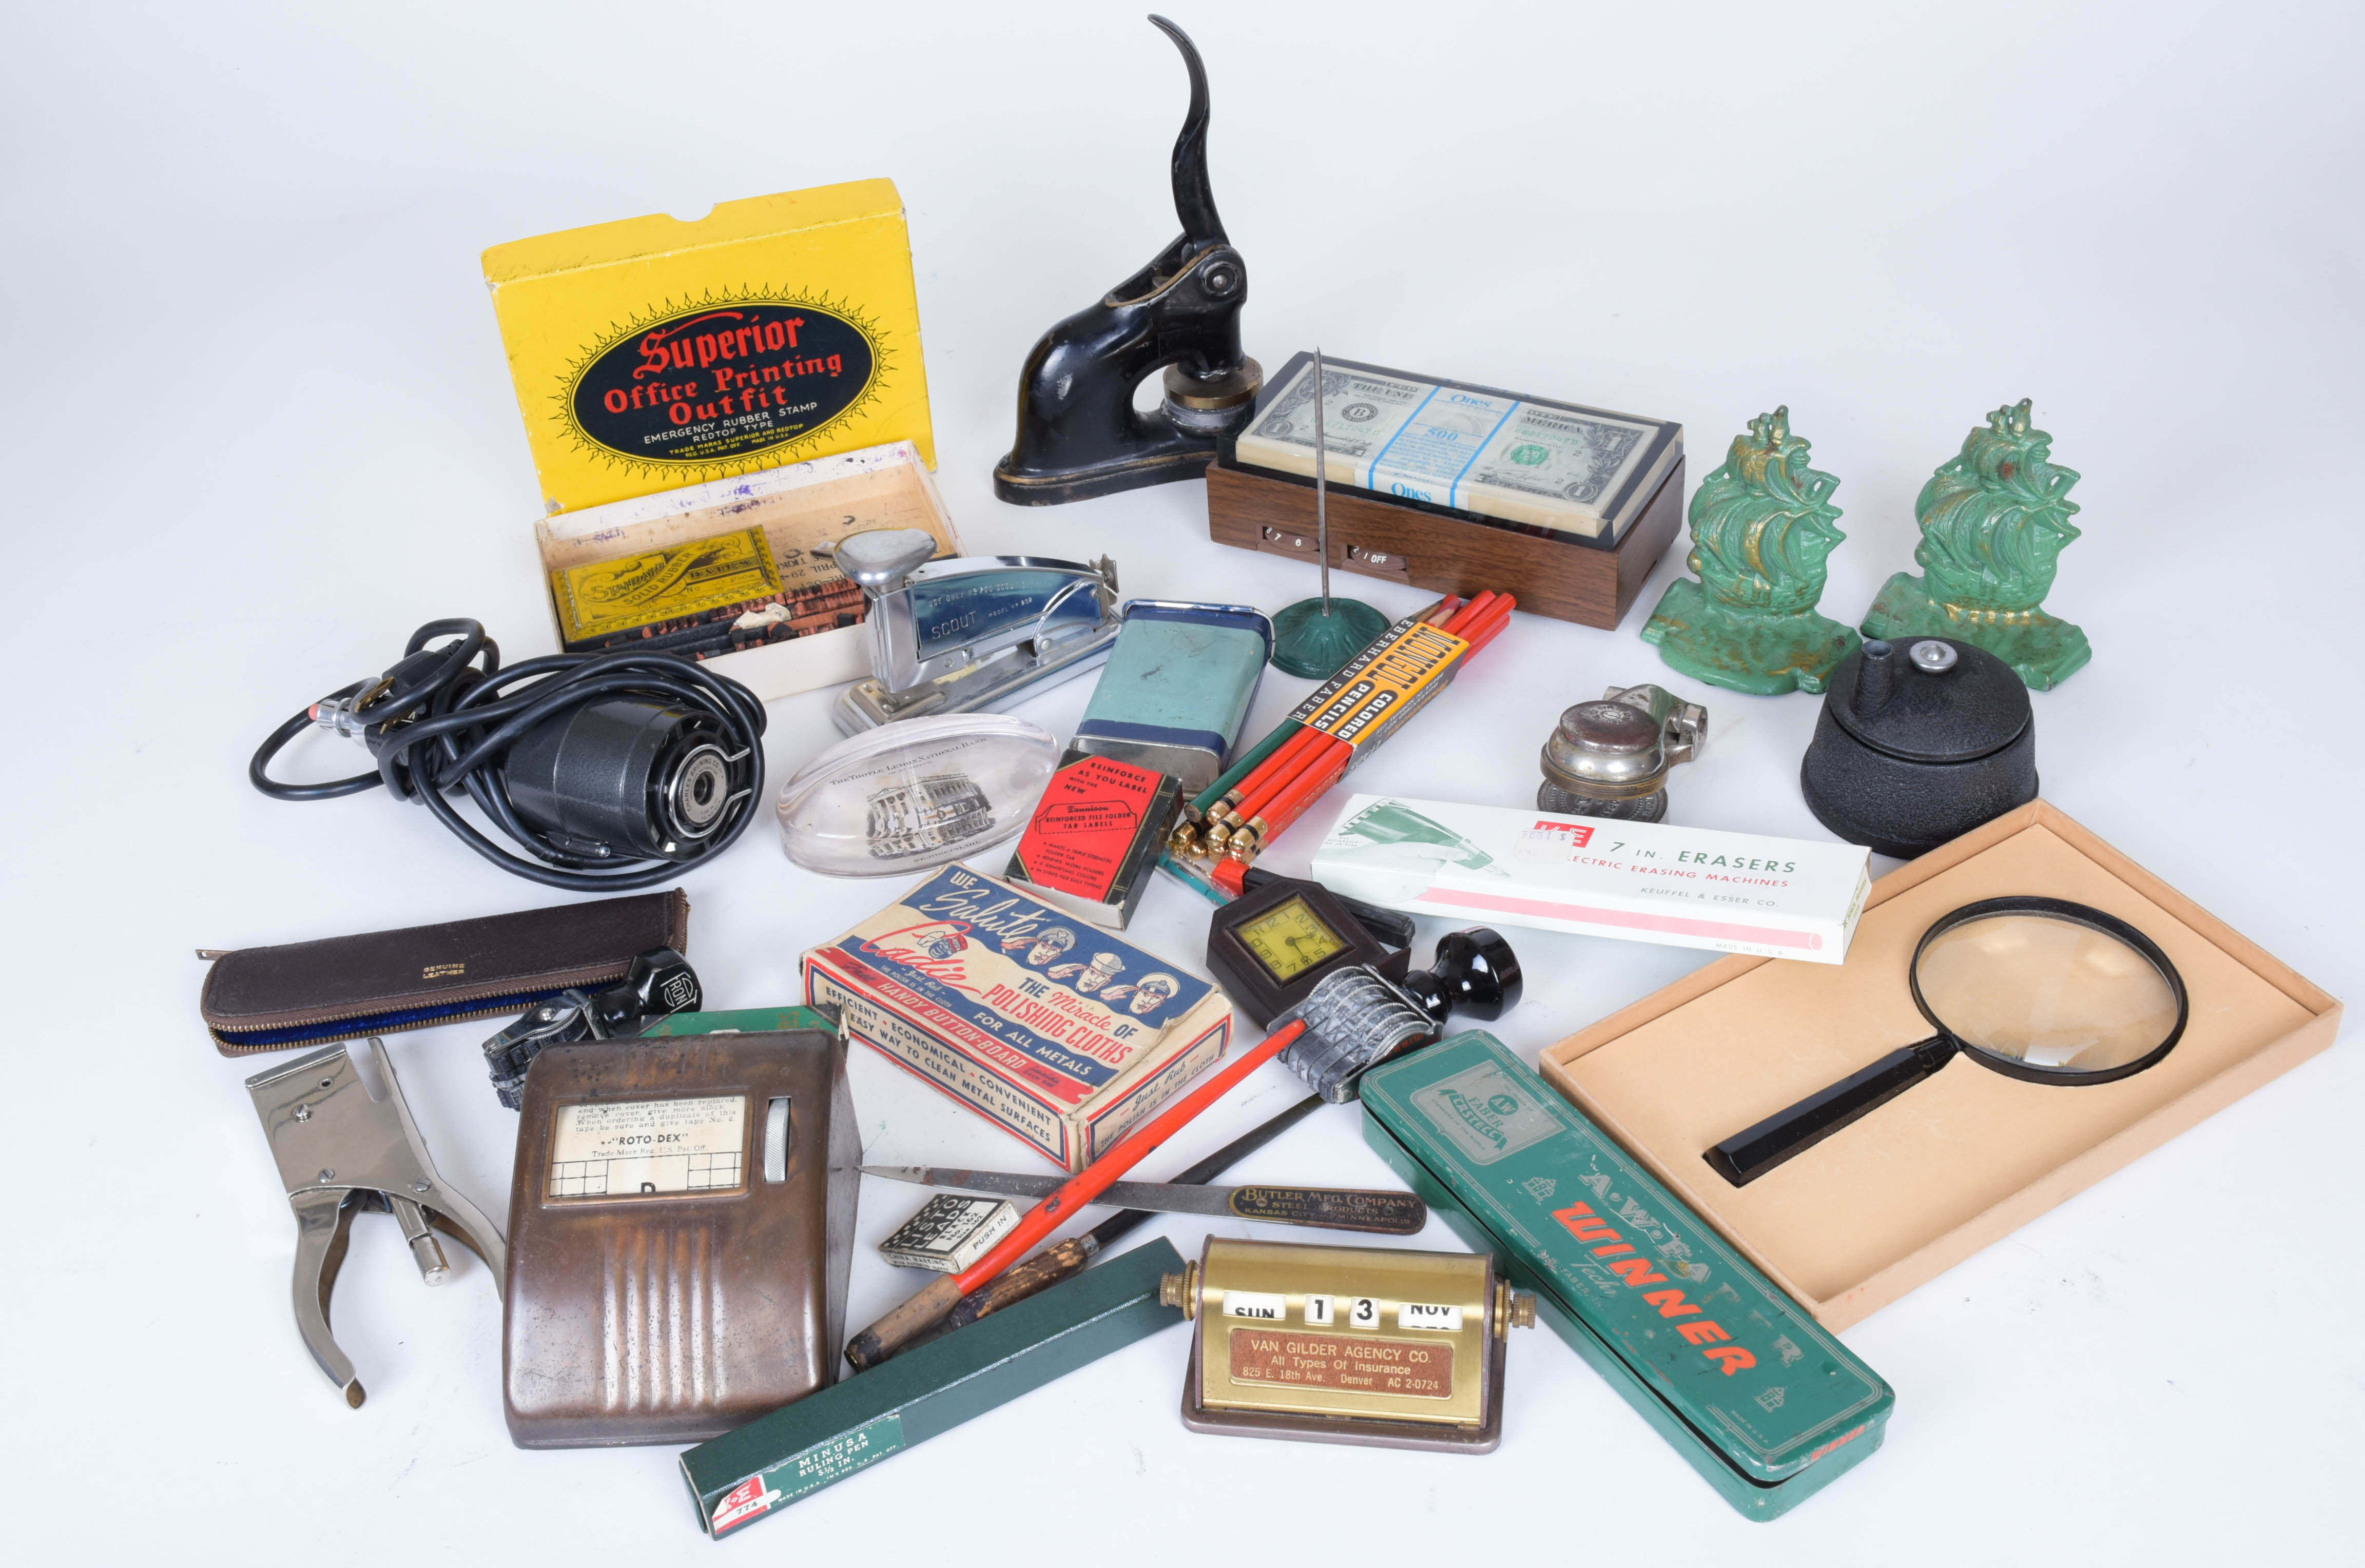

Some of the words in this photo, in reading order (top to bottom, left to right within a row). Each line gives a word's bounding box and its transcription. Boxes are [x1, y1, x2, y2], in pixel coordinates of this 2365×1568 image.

[632, 311, 805, 380] Superior
[604, 381, 699, 414] Office
[712, 352, 842, 393] Printing
[669, 385, 788, 425] Outfit
[1450, 394, 1492, 408] Ones
[644, 422, 715, 444] EMERGENCY
[723, 412, 770, 428] RUBBER
[779, 402, 818, 417] STAMP
[693, 428, 736, 442] REDTOP
[744, 420, 773, 432] TYPE
[1424, 427, 1459, 442] 500
[669, 445, 695, 455] TRADE
[697, 440, 722, 449] MARKS
[725, 433, 760, 444] SUPERIOR
[777, 424, 804, 433] REDTOP
[1391, 482, 1432, 502] Ones
[1371, 555, 1387, 564] OFF
[590, 561, 665, 599] STANDARD
[623, 583, 660, 604] SOLID
[661, 551, 694, 584] RUBBER
[932, 611, 976, 640] SCOUT
[1343, 619, 1414, 678] EBERHARD
[1365, 626, 1461, 690] MONGOL
[1295, 681, 1342, 719] FABER
[1314, 683, 1371, 730] PENCILS
[1337, 693, 1393, 739] COLORED
[690, 758, 711, 776] BRUNING
[1091, 762, 1146, 782] REINFORCE
[1064, 784, 1087, 794] NEW
[1096, 774, 1116, 784] YOU
[1119, 781, 1148, 793] LABEL
[1610, 842, 1626, 852] 7
[1636, 849, 1662, 859] IN.
[1678, 851, 1796, 873] ERASERS
[950, 871, 978, 890] WE
[1631, 866, 1697, 878] ERASING
[1705, 874, 1789, 887] MACHINES
[1641, 888, 1690, 898] KEUFFEL
[1713, 895, 1749, 904] ESSER
[919, 889, 1050, 939] Salute
[423, 963, 466, 973] GENUINE
[860, 920, 982, 996] Cadie
[422, 969, 465, 979] LEATHER
[891, 971, 909, 986] POLISH
[925, 990, 935, 998] THE
[935, 997, 953, 1008] CLOTH
[981, 983, 1075, 1038] POLISHING
[1065, 1026, 1134, 1064] CLOTHS
[1019, 977, 1050, 999] THE
[1048, 991, 1112, 1031] Miracle
[1113, 1024, 1139, 1039] OF
[877, 982, 928, 1008] HANDY
[923, 1008, 1028, 1070] BUTTON-BOARD
[826, 986, 878, 1020] EFFICIENT
[891, 1022, 965, 1073] ECONOMICAL
[979, 1075, 1051, 1125] CONVENIENT
[974, 1012, 1003, 1031] FOR
[1005, 1031, 1034, 1048] ALL
[1036, 1046, 1092, 1075] METALS
[850, 1013, 874, 1032] EASY
[880, 1029, 901, 1047] WAY
[906, 1046, 919, 1059] TO
[925, 1057, 956, 1082] CLEAN
[962, 1079, 995, 1105] METAL
[1001, 1103, 1050, 1142] SURFACES
[1133, 1082, 1160, 1112] Just
[1164, 1061, 1186, 1084] Rub
[1100, 1132, 1114, 1148] THE
[1119, 1108, 1146, 1132] POLISH
[1150, 1099, 1157, 1109] IS
[1161, 1088, 1170, 1100] IN
[1174, 1075, 1187, 1089] THE
[1191, 1053, 1214, 1075] CLOTH
[1468, 1097, 1504, 1128] FABER
[1242, 1188, 1304, 1201] BUTLER
[1346, 1193, 1416, 1209] COMPANY
[1272, 1201, 1308, 1209] STEEL
[1319, 1205, 1379, 1215] PRODUCTS
[900, 1199, 958, 1248] LISTO
[914, 1200, 971, 1249] LEADS
[939, 1211, 971, 1240] BLACK
[973, 1228, 995, 1250] PUSH
[997, 1216, 1007, 1226] IN
[1337, 1214, 1410, 1224] MINNEAPOLIS
[1551, 1201, 1757, 1377] WINNER
[1315, 1299, 1324, 1319] 1
[1356, 1299, 1373, 1320] 3
[1411, 1305, 1451, 1316] NOV
[1251, 1339, 1279, 1351] VAN
[1286, 1342, 1337, 1356] GILDER
[1345, 1346, 1402, 1360] AGENCY
[1408, 1351, 1431, 1363] CO.
[1271, 1356, 1285, 1365] All
[1292, 1357, 1326, 1369] Types
[1334, 1359, 1347, 1370] Of
[1355, 1362, 1411, 1375] Insurance
[1243, 1366, 1261, 1377] 825
[1266, 1368, 1274, 1379] E.
[1280, 1369, 1301, 1380] 18th
[1306, 1371, 1326, 1382] Ave.
[1341, 1374, 1373, 1386] Denver
[1387, 1378, 1401, 1388] AC
[1406, 1379, 1439, 1390] 2-0724
[799, 1432, 867, 1468] MINUSA
[799, 1453, 843, 1477] RULING
[847, 1440, 868, 1455] PEN
[838, 1457, 855, 1467] IN.
[736, 1501, 758, 1514] 774
[778, 1493, 793, 1502] MADE
